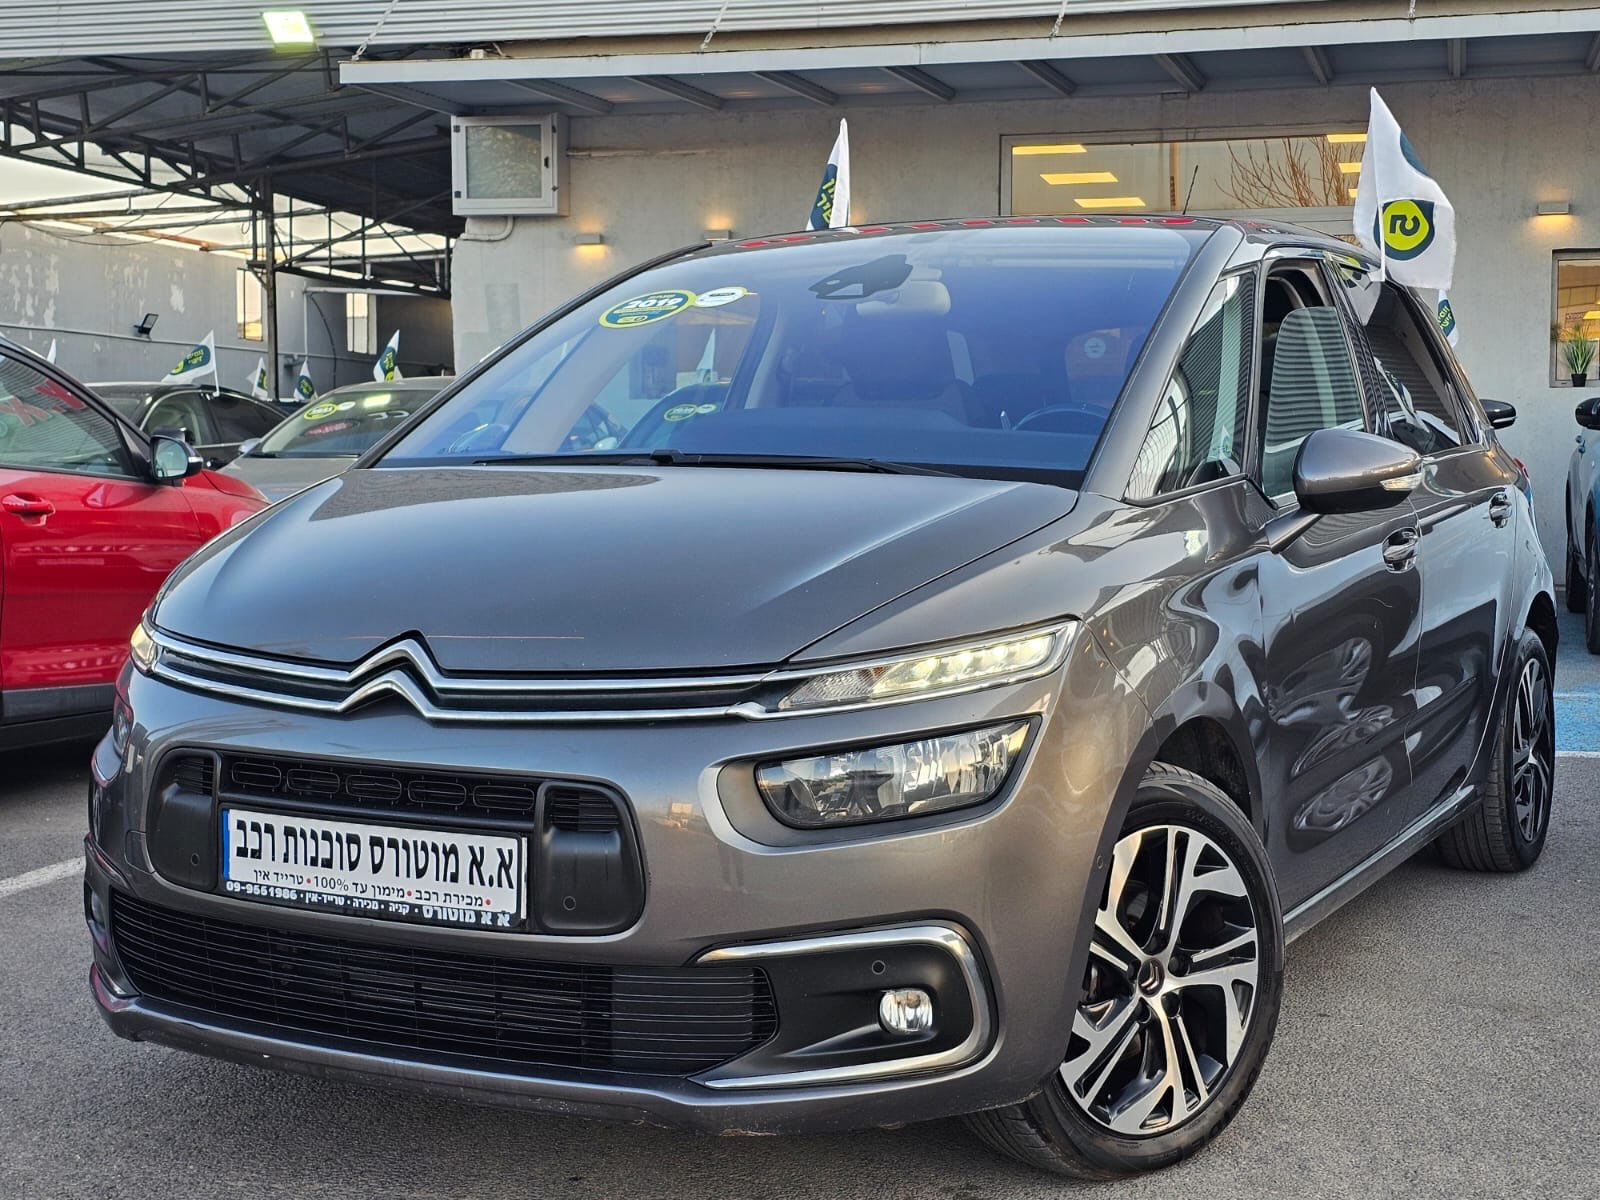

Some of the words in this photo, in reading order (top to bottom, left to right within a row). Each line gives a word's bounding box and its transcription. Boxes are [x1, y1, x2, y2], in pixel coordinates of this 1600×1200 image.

[236, 819, 276, 862] רכב
[283, 825, 361, 872] סוכנות
[369, 834, 460, 883] מוטורס
[468, 845, 514, 890] א.א
[253, 869, 271, 881] אין
[273, 871, 304, 885] טרייד
[313, 876, 349, 891] 100%
[352, 882, 368, 895] עד
[371, 885, 405, 898] מימון
[415, 889, 439, 902] רכב
[352, 898, 379, 910] מכירה
[443, 892, 484, 907] מכירת
[388, 902, 410, 916] קניה
[422, 905, 477, 923] מוטורס
